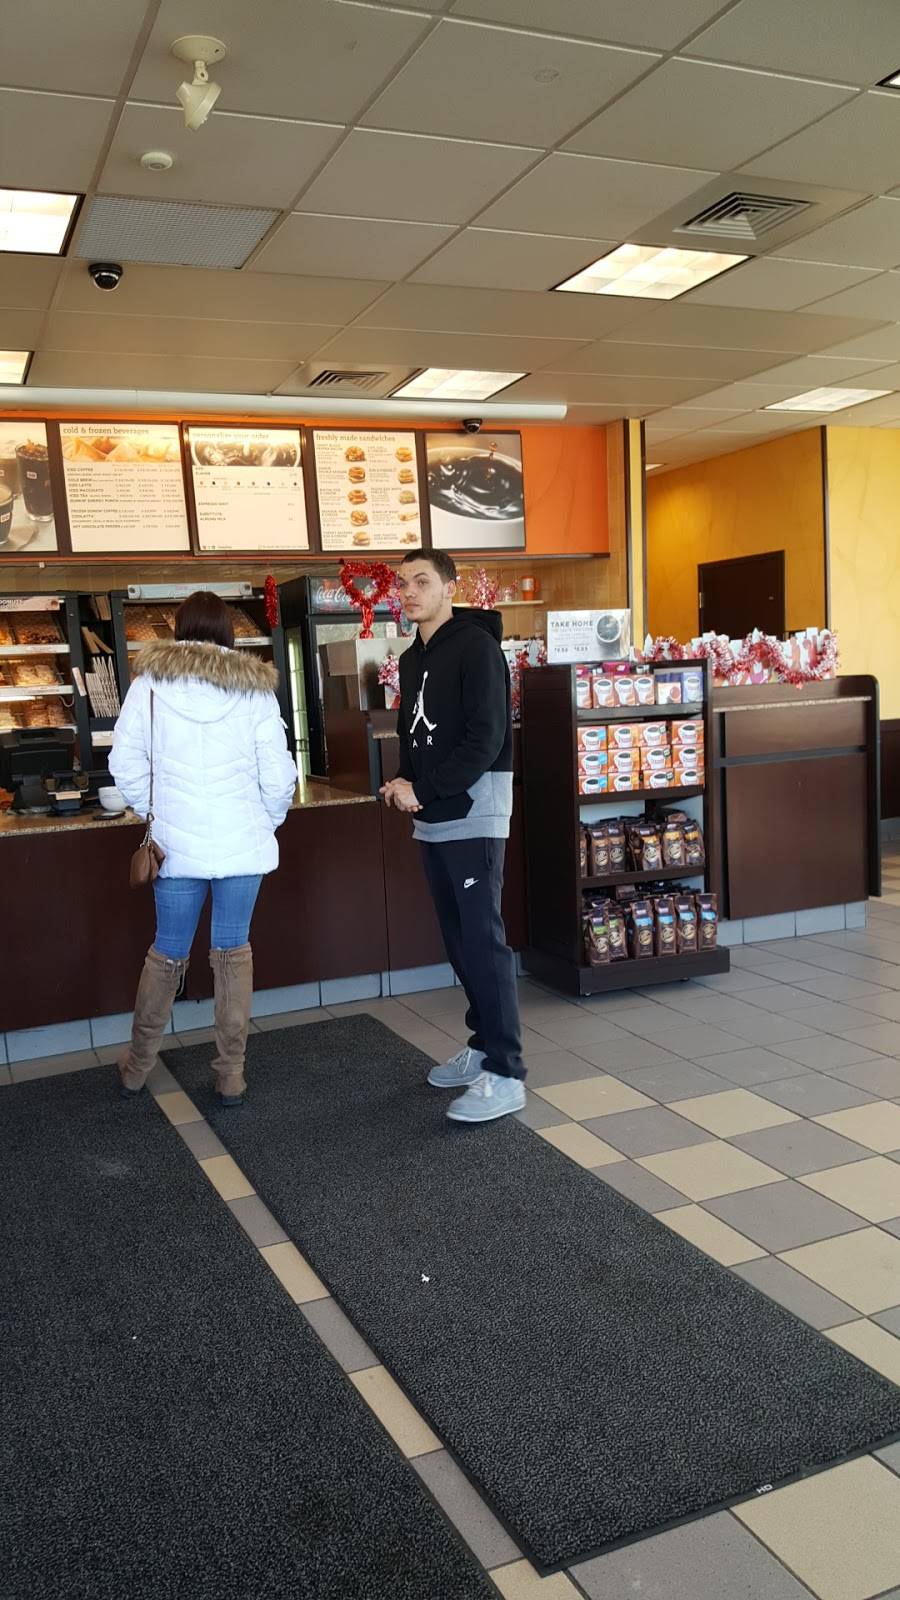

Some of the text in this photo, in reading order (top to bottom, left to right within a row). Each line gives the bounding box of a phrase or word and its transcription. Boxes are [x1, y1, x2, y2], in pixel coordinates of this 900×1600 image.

[63, 426, 79, 434] cold
[316, 433, 339, 442] freshly
[550, 620, 570, 628] TAKE
